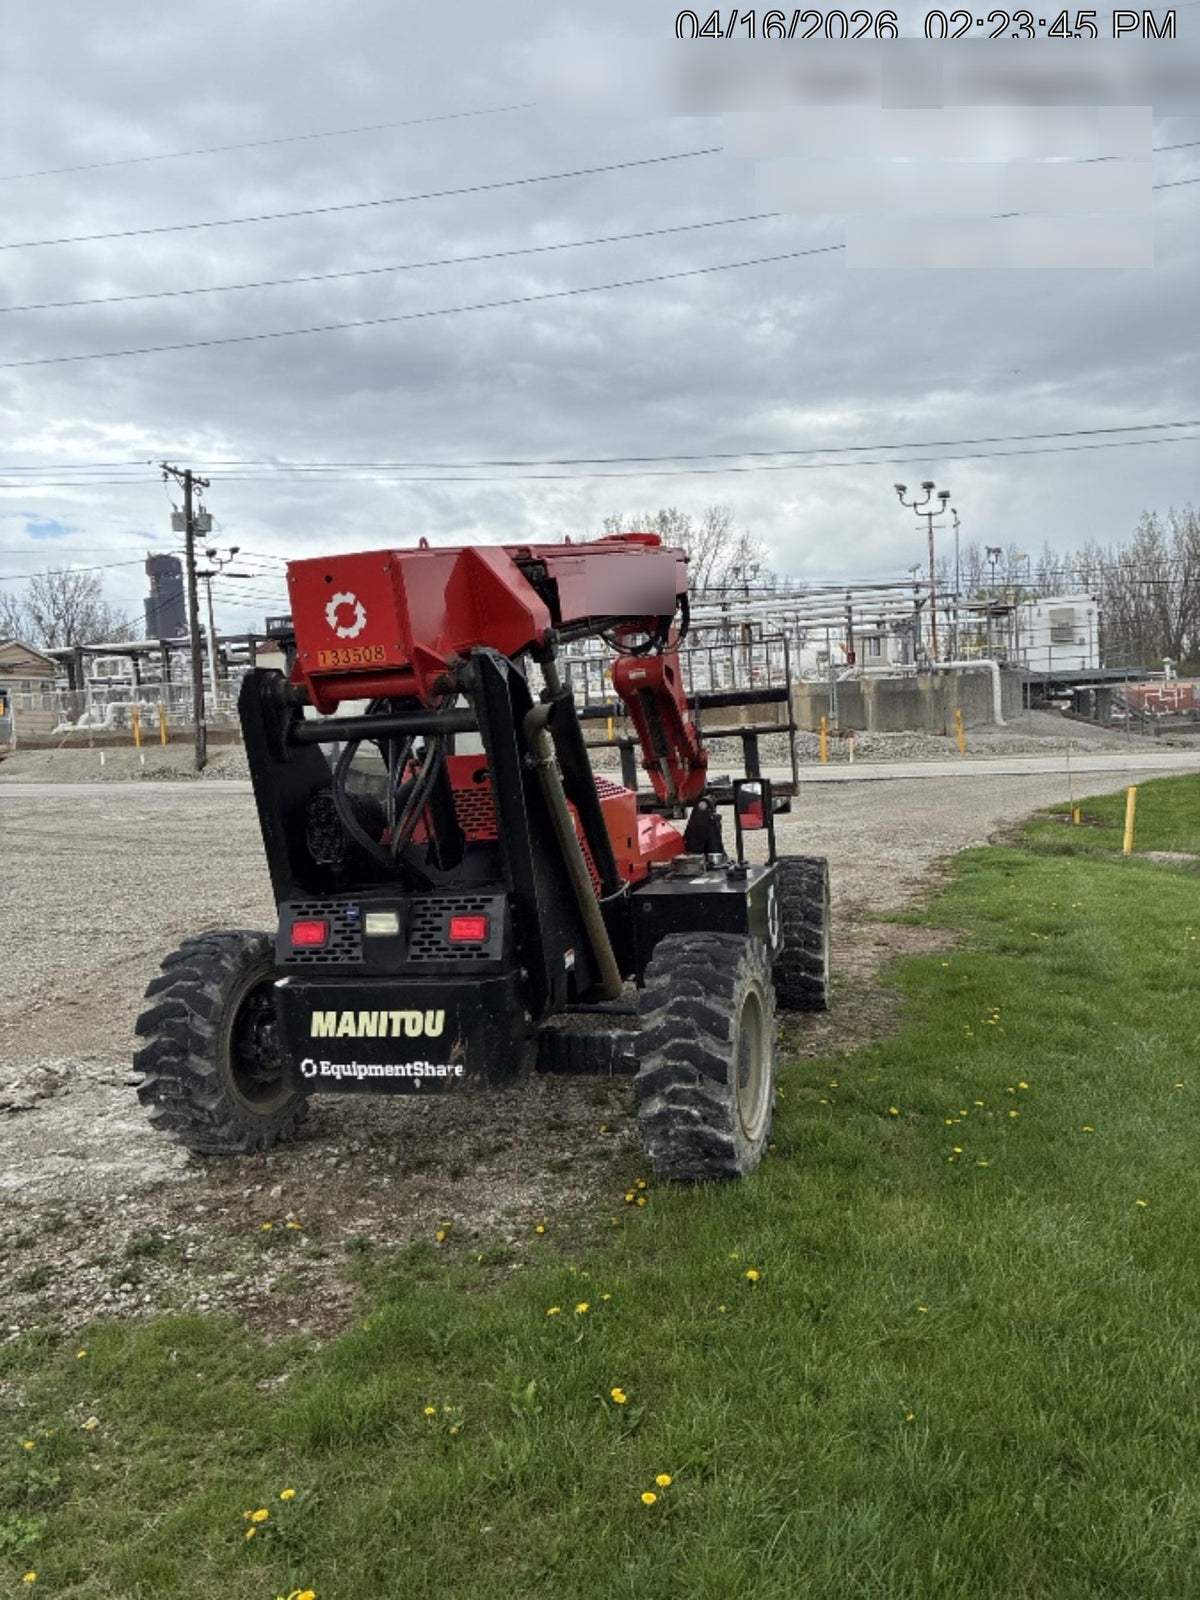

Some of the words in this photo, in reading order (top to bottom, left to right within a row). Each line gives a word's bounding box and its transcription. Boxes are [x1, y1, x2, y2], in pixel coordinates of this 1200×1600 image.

[319, 646, 385, 666] 133508
[310, 1009, 446, 1038] MANITOU
[319, 1060, 464, 1080] EquipmentShare
